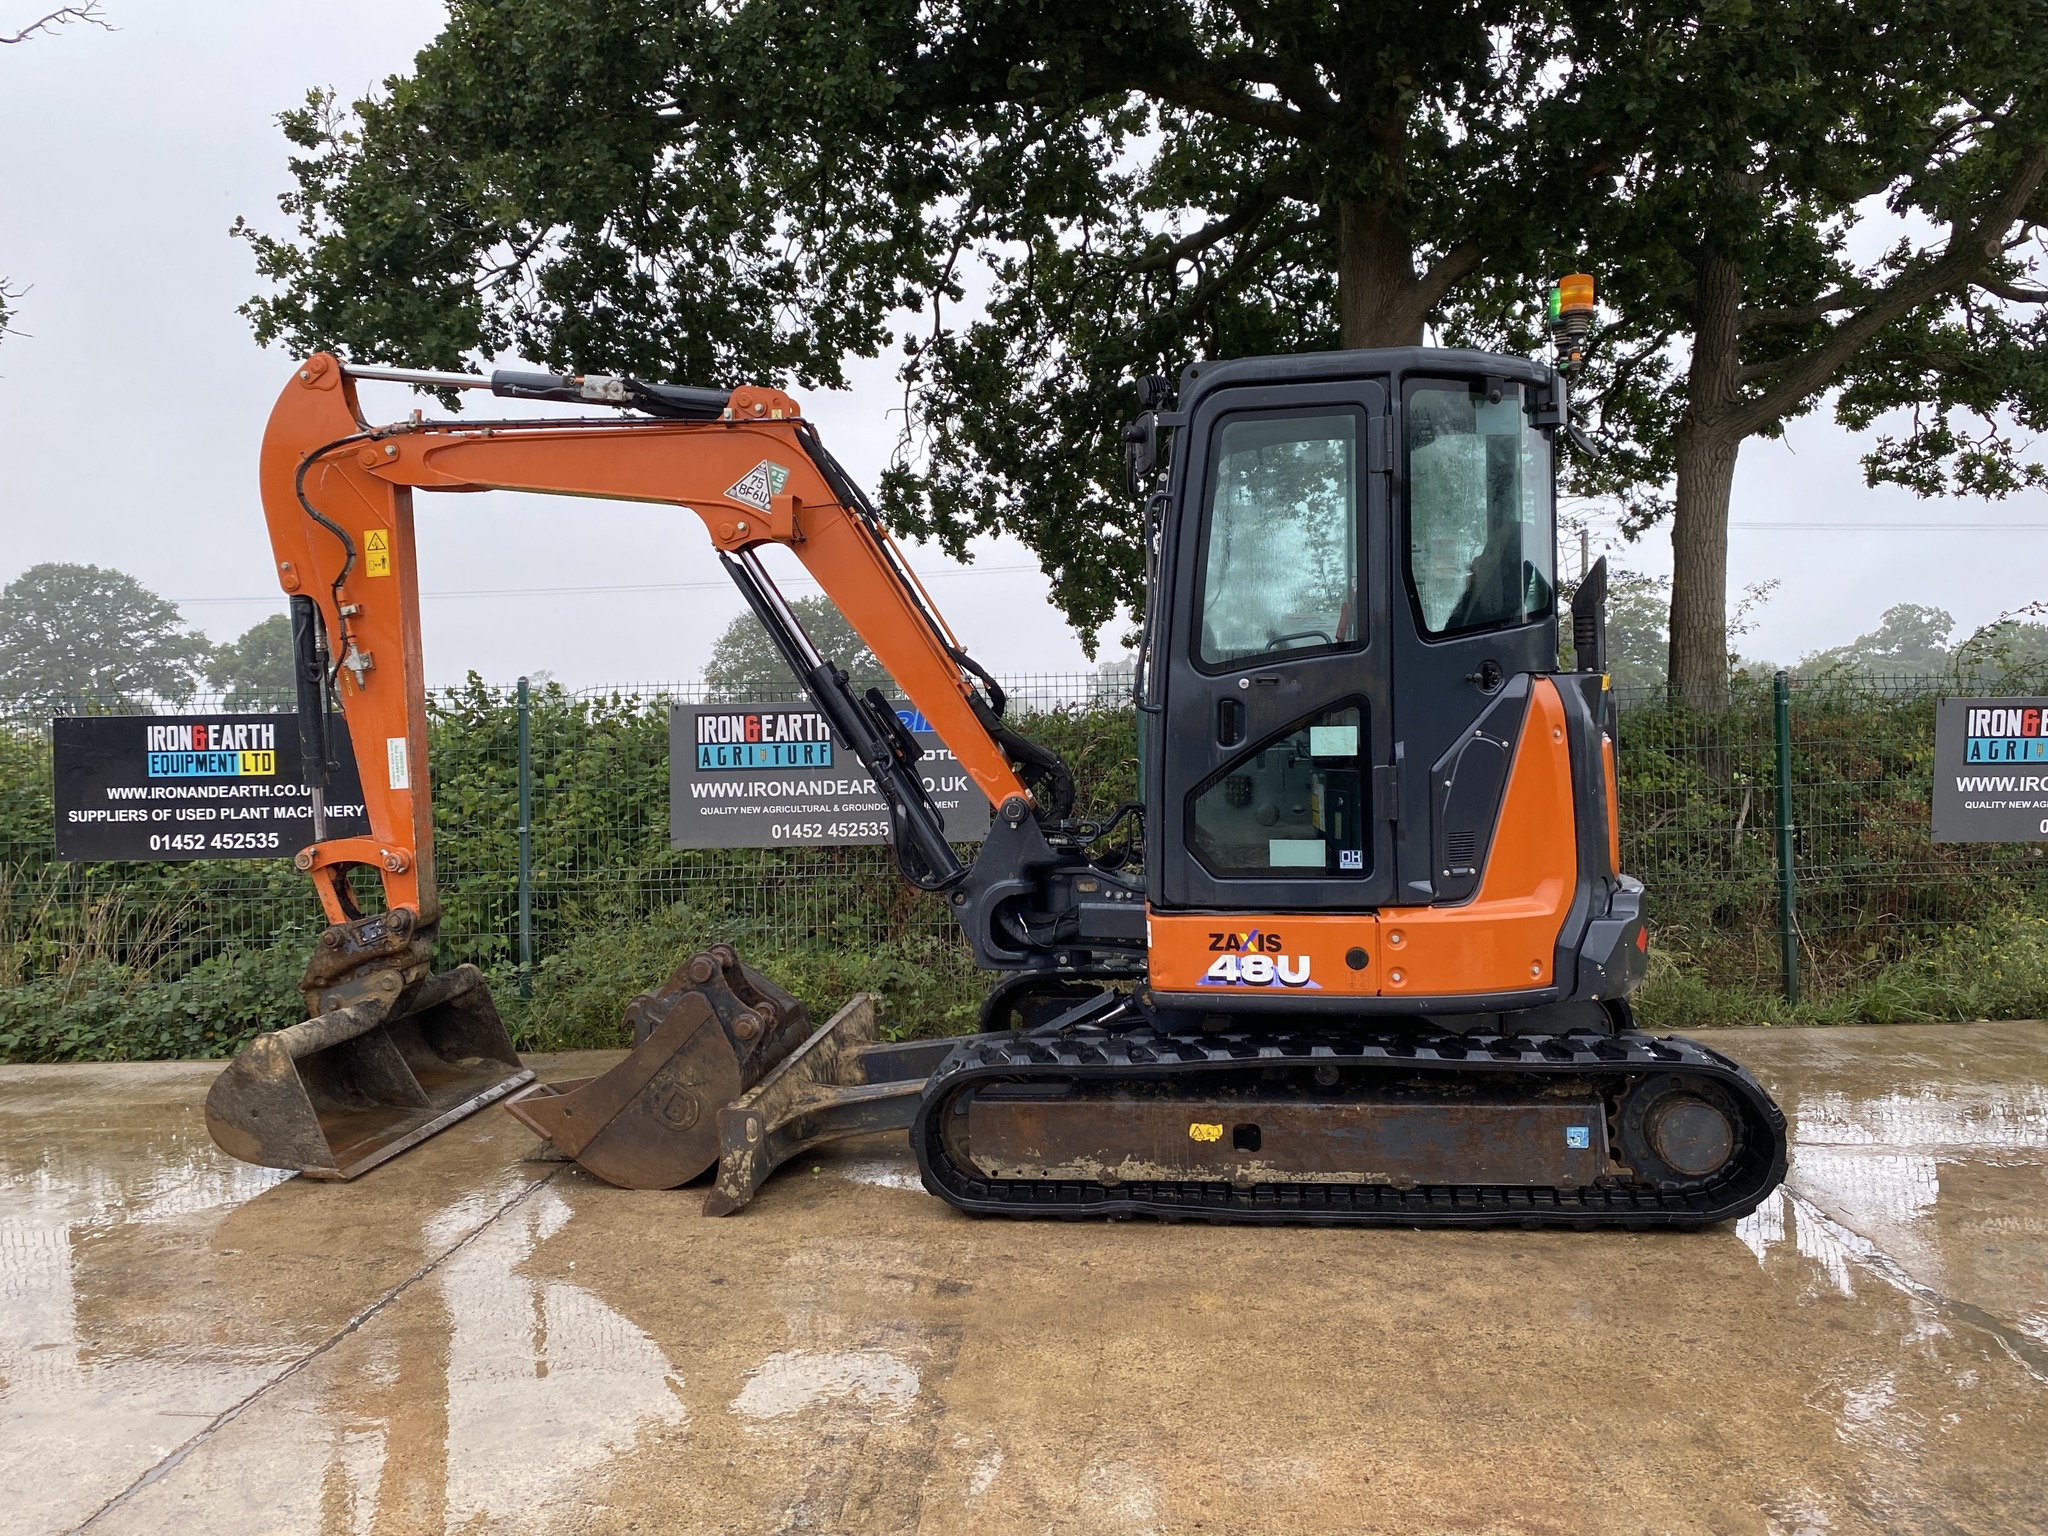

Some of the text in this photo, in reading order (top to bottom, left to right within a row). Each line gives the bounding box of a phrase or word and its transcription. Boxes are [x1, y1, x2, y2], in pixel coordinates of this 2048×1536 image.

[751, 475, 765, 489] 75
[776, 473, 785, 482] 5
[738, 484, 768, 503] BF6U
[702, 744, 828, 766] AGRI TURF
[1970, 740, 2029, 760] AGRI
[151, 752, 272, 776] EQUIPMENT LTD
[106, 784, 311, 800] WWW.IRONANDEARTH.CO.U
[68, 804, 365, 823] SUPPLIERS OF USED PLANT MACHNERY
[700, 806, 738, 815] QUALITY
[740, 806, 761, 814] NEW
[762, 804, 831, 814] AGRICULTURAL
[833, 804, 840, 812] &
[842, 803, 889, 812] GROUNDC
[1964, 801, 2007, 809] QUALITY
[2008, 801, 2031, 809] NEW
[771, 821, 889, 839] 01452 452535
[150, 832, 279, 850] 01452 452535
[1208, 928, 1282, 953] ZAXIS
[1207, 954, 1311, 987] 48U
